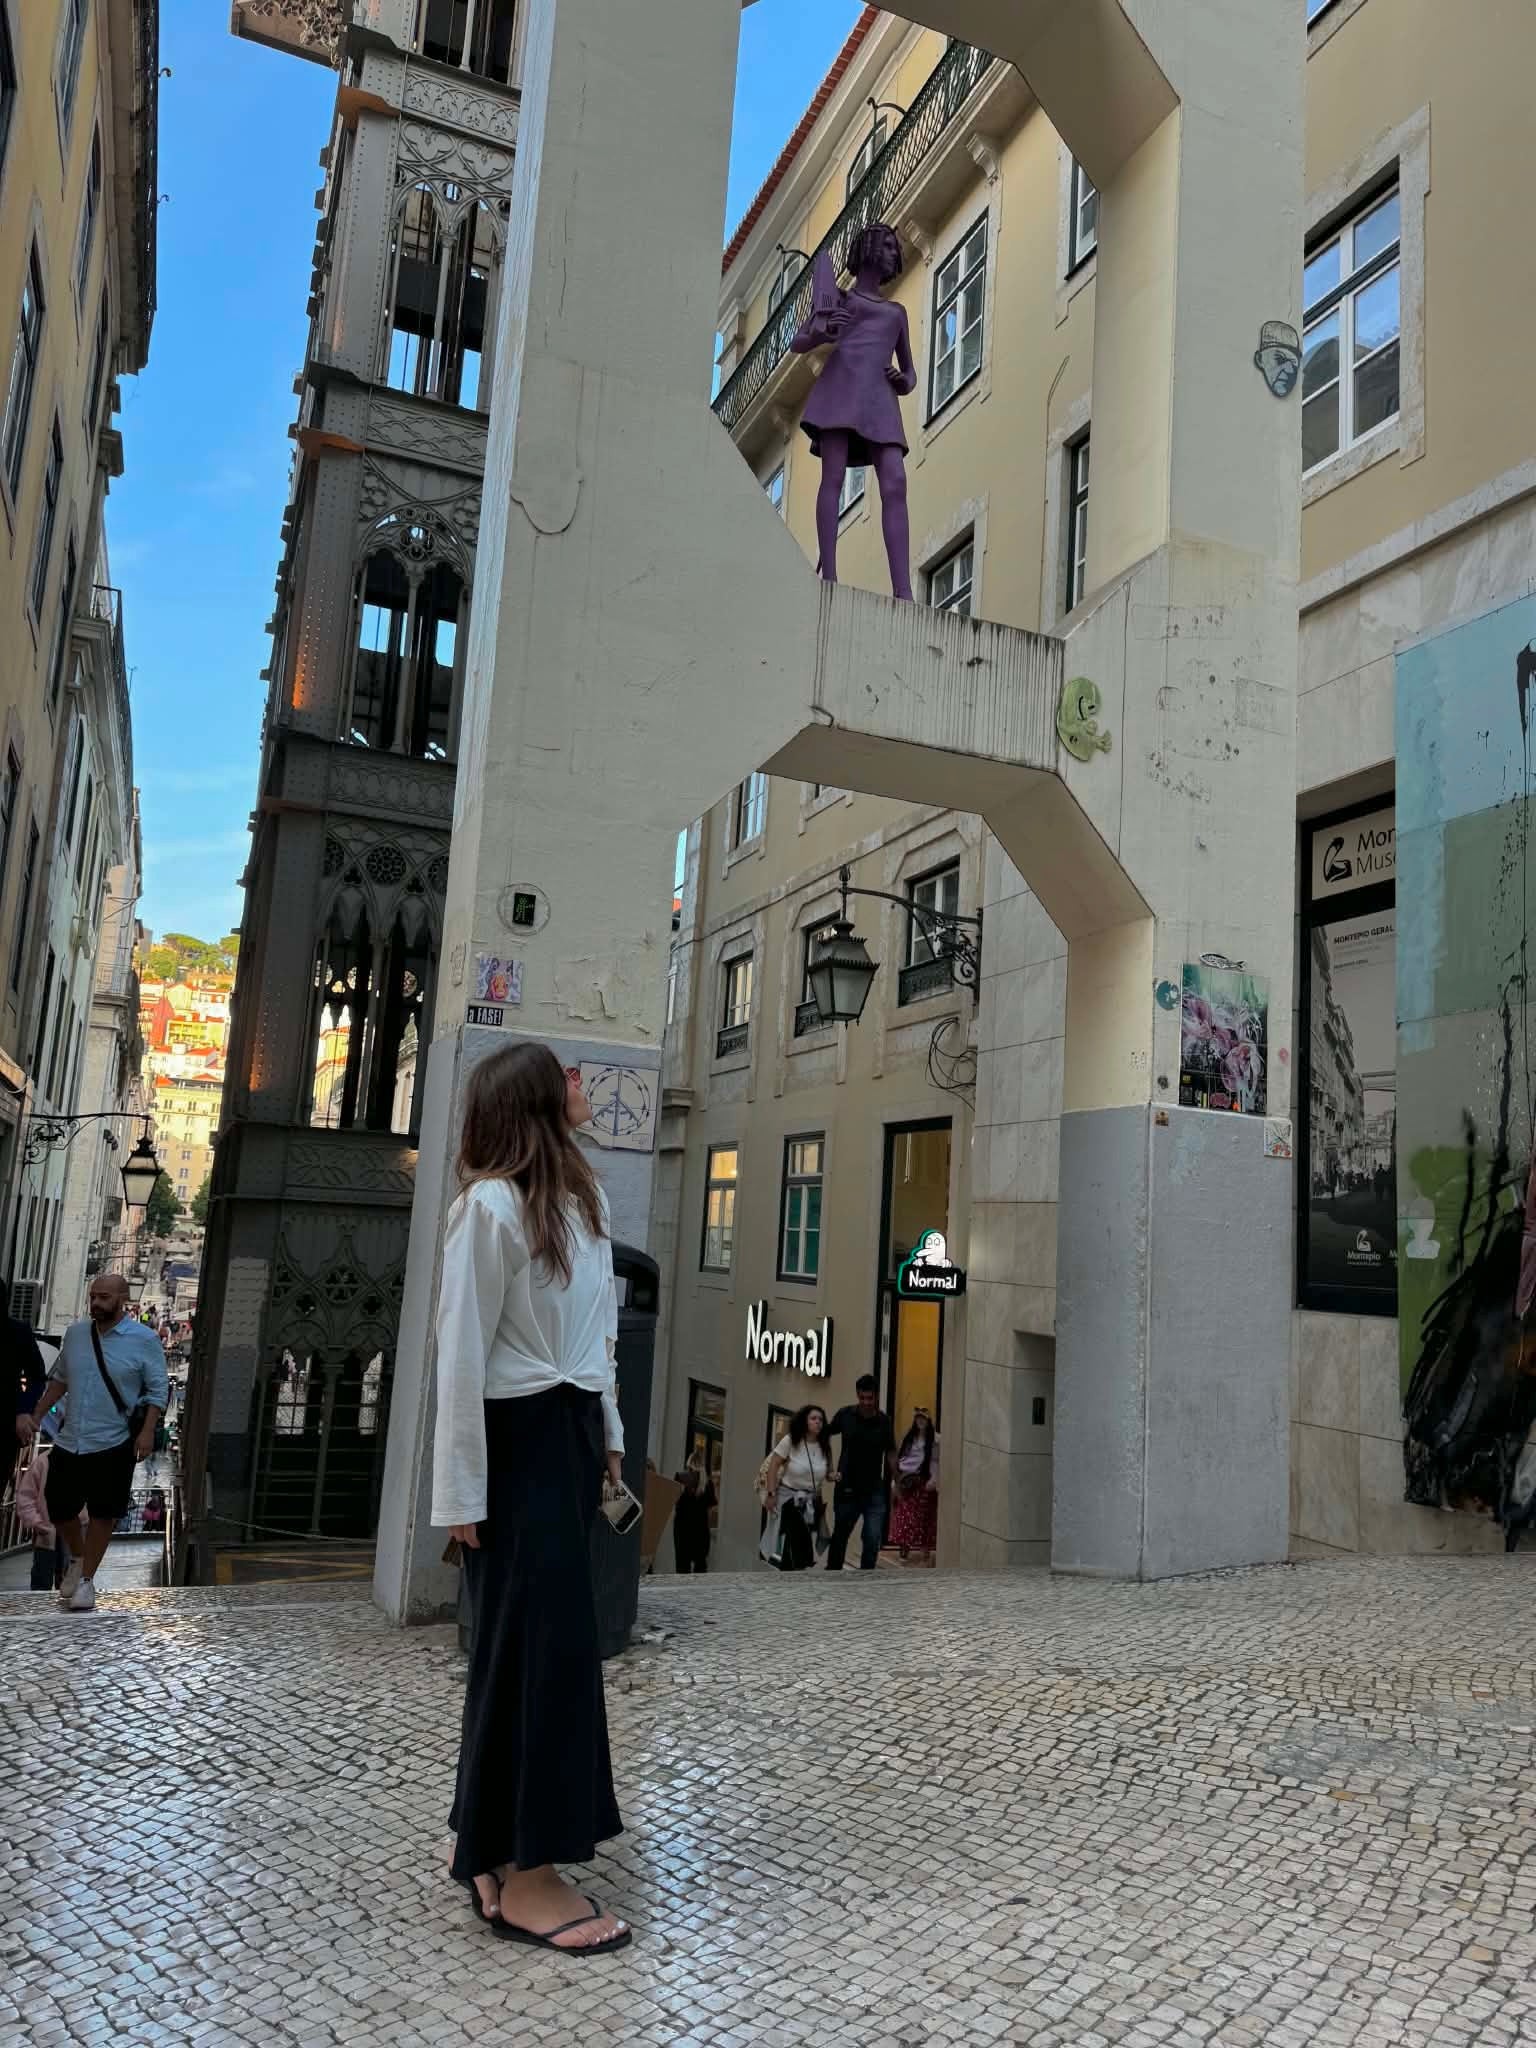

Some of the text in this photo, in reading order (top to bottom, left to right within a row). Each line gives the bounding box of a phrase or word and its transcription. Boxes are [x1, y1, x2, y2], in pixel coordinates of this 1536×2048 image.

[1356, 851, 1396, 876] Mus
[908, 1268, 957, 1290] Normal
[745, 1299, 829, 1378] Normal
